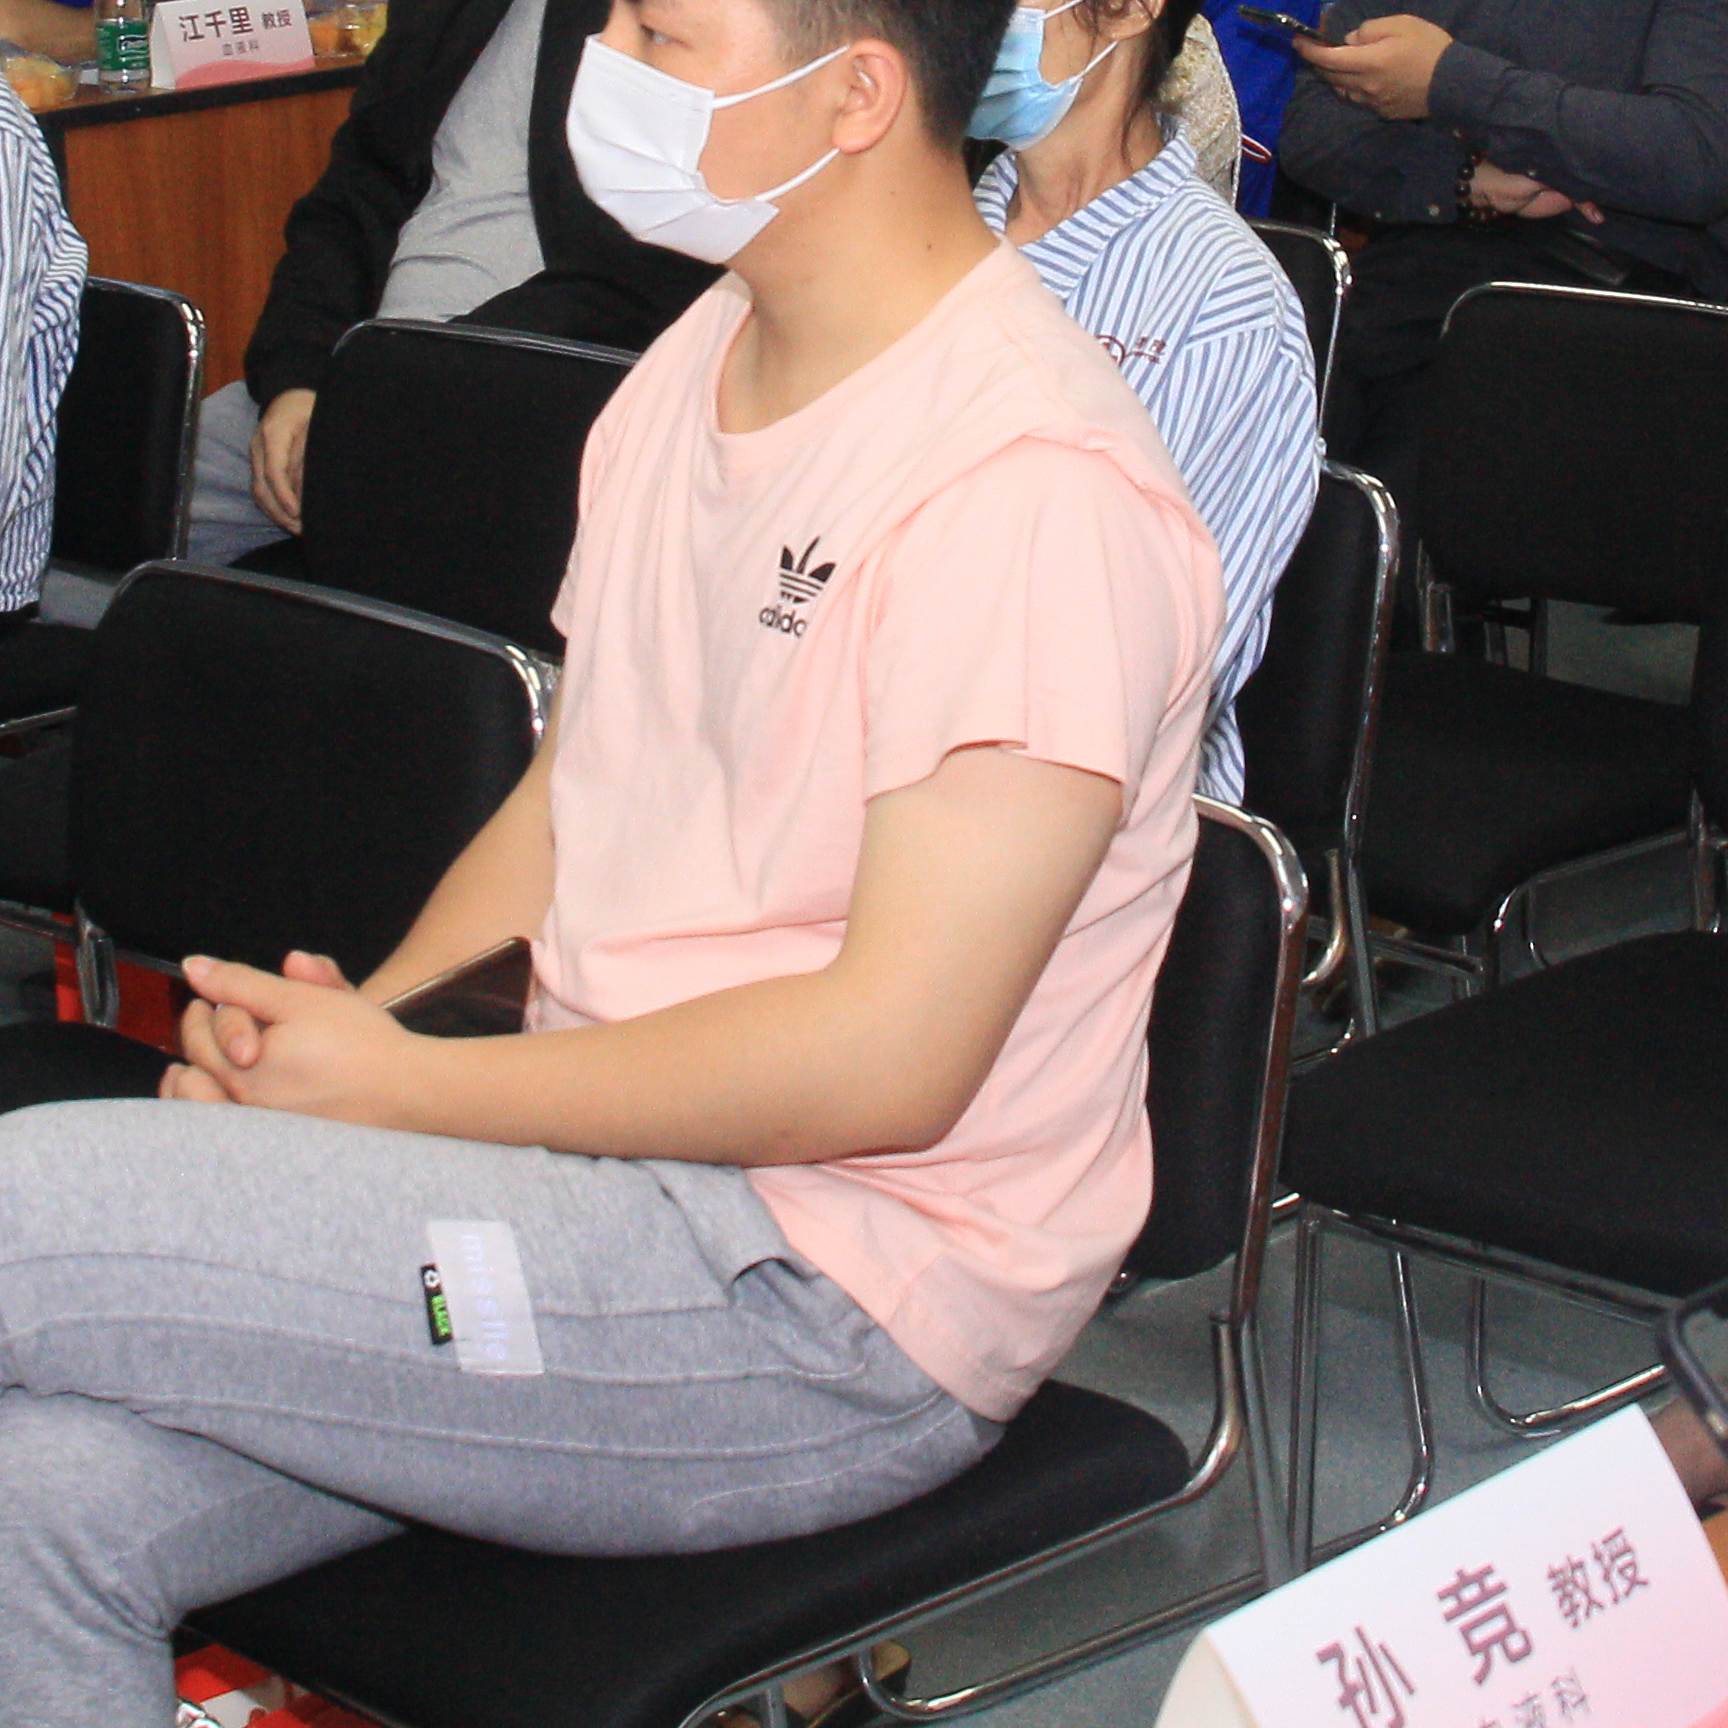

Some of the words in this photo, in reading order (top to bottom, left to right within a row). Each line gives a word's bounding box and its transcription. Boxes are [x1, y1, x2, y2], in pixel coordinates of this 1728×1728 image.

[178, 6, 254, 42] 江千里
[260, 8, 293, 31] 教授
[1546, 1525, 1651, 1629] 教授
